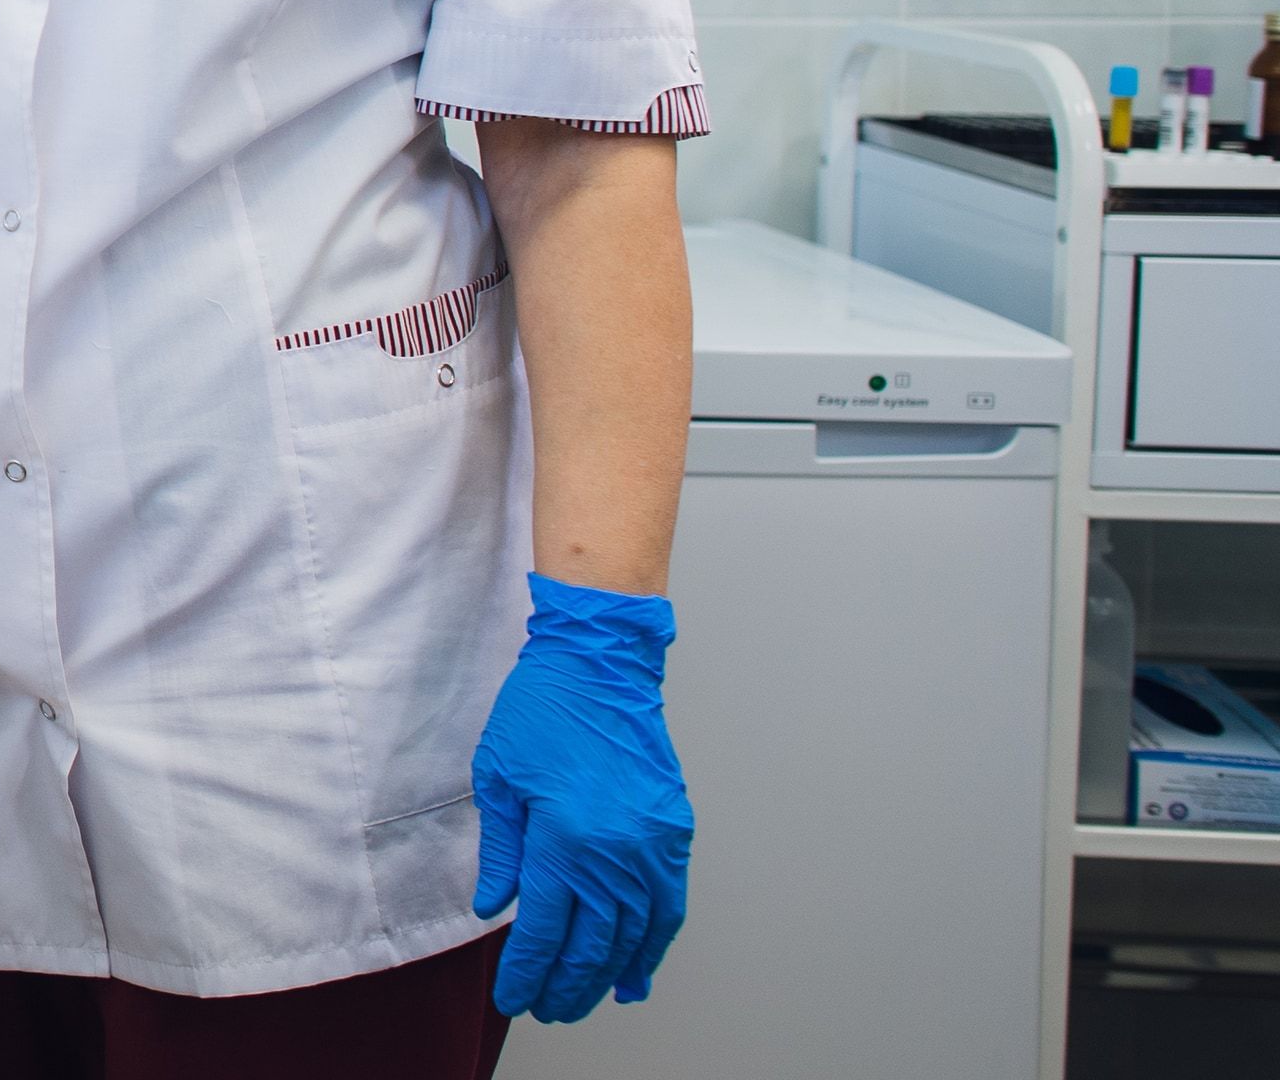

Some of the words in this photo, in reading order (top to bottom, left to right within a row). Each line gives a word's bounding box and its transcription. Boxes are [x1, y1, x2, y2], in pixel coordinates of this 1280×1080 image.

[818, 396, 848, 408] Easy
[853, 396, 880, 406] cool
[883, 398, 929, 409] system
